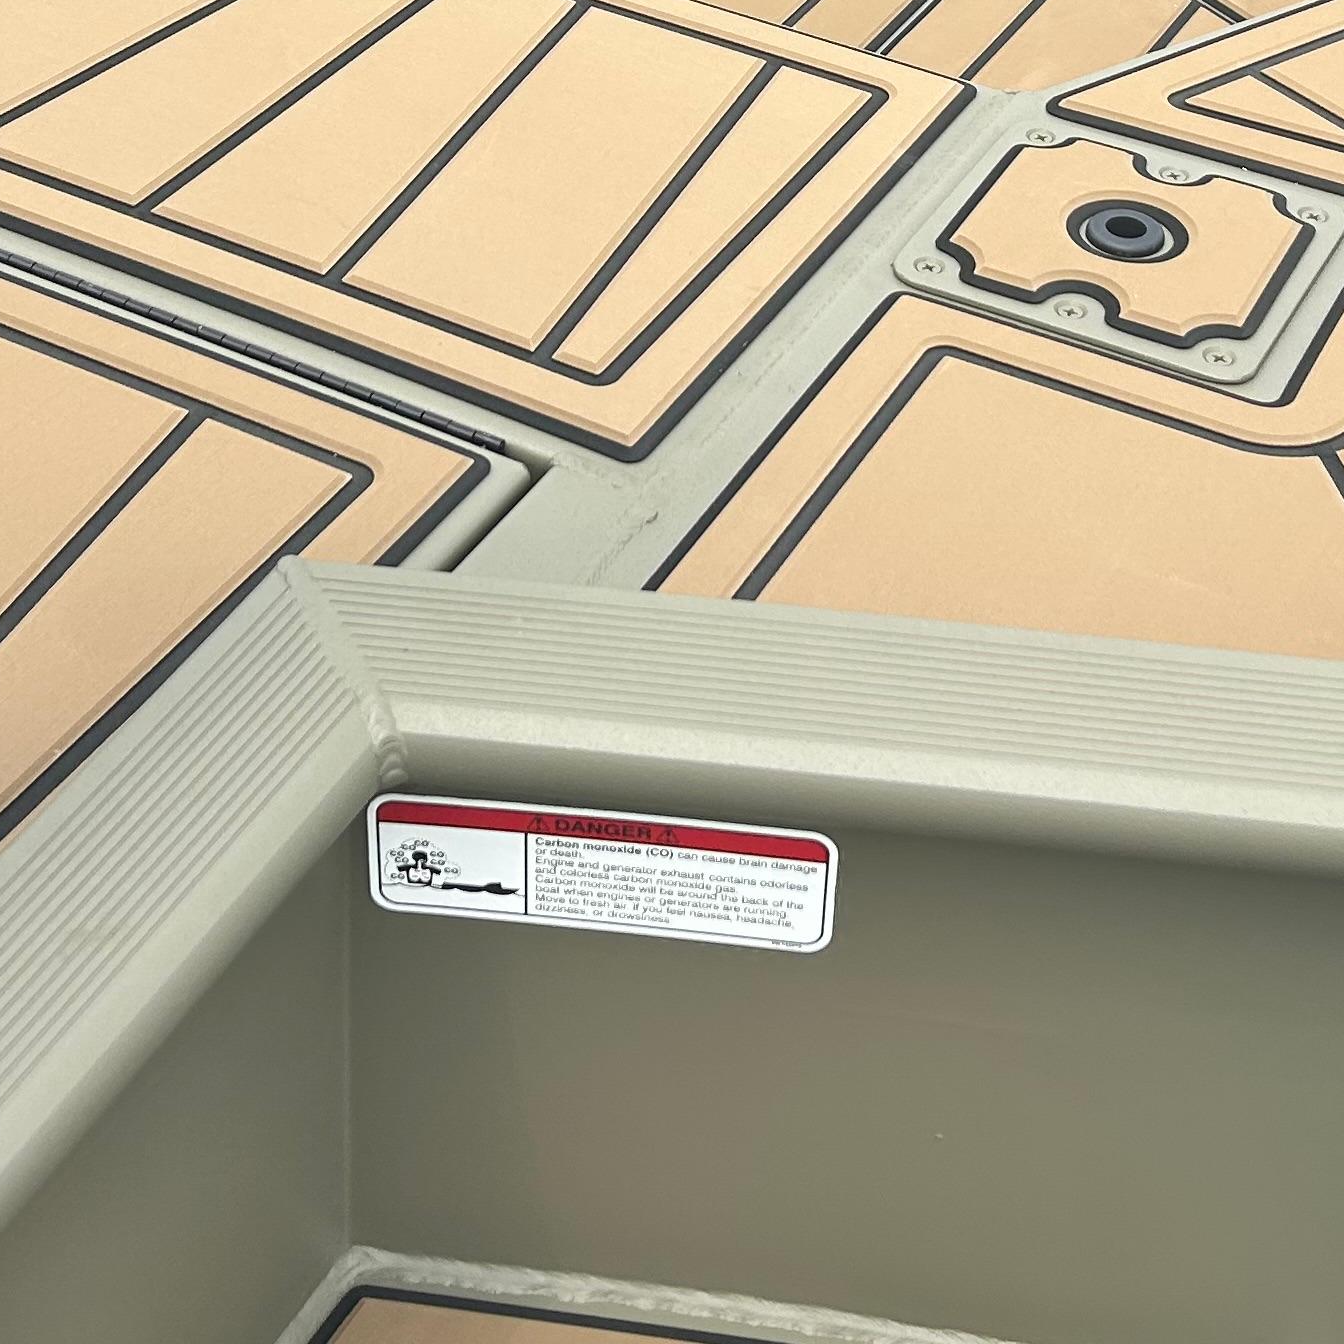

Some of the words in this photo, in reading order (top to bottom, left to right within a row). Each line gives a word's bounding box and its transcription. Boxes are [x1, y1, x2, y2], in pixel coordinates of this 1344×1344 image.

[555, 818, 652, 840] DANGER
[535, 837, 579, 849] Carbon
[583, 842, 642, 854] monoxide
[646, 847, 674, 859] (CO)
[678, 852, 698, 860] can
[702, 855, 735, 864] cause
[739, 857, 768, 868] brain
[771, 861, 818, 874] damage
[535, 866, 556, 874] and
[560, 869, 609, 880] colorless
[614, 872, 652, 884] carbon
[656, 878, 712, 890] monoxide
[536, 856, 574, 867] Engine
[578, 860, 599, 869] and
[603, 864, 657, 875] generator
[660, 869, 704, 880] exhaust
[709, 875, 756, 886] contains
[760, 880, 808, 891] odorless
[535, 874, 576, 886] Carbon
[580, 880, 635, 891] monoxide
[639, 884, 656, 894] will
[721, 893, 738, 903] the
[742, 895, 768, 906] back
[787, 900, 804, 910] the
[536, 894, 565, 904] Move
[564, 888, 593, 897] when
